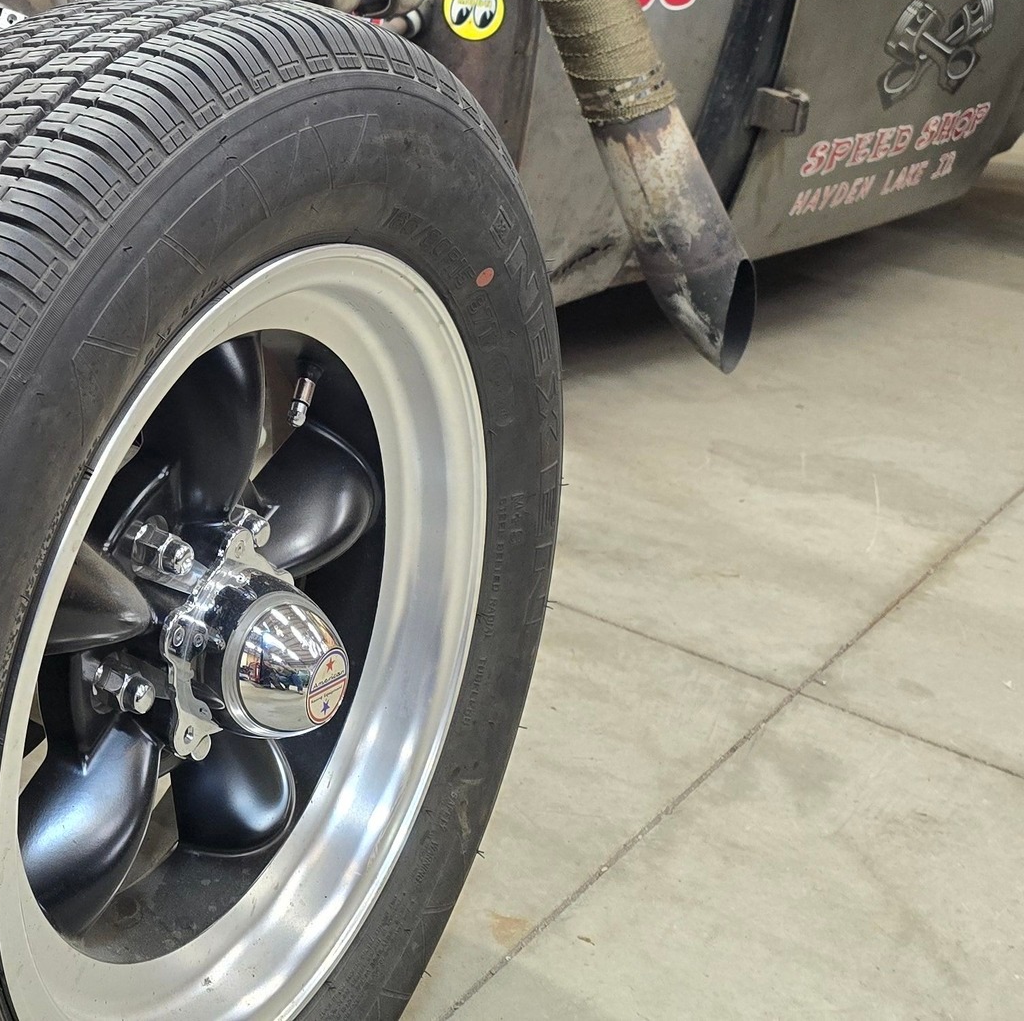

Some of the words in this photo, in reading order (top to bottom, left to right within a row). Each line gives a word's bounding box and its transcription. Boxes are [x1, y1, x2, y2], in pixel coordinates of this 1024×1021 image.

[799, 123, 915, 178] SPEED
[914, 100, 992, 151] SHOP
[787, 174, 877, 217] HAYDEN
[879, 159, 930, 196] LAKE
[312, 669, 345, 690] American
